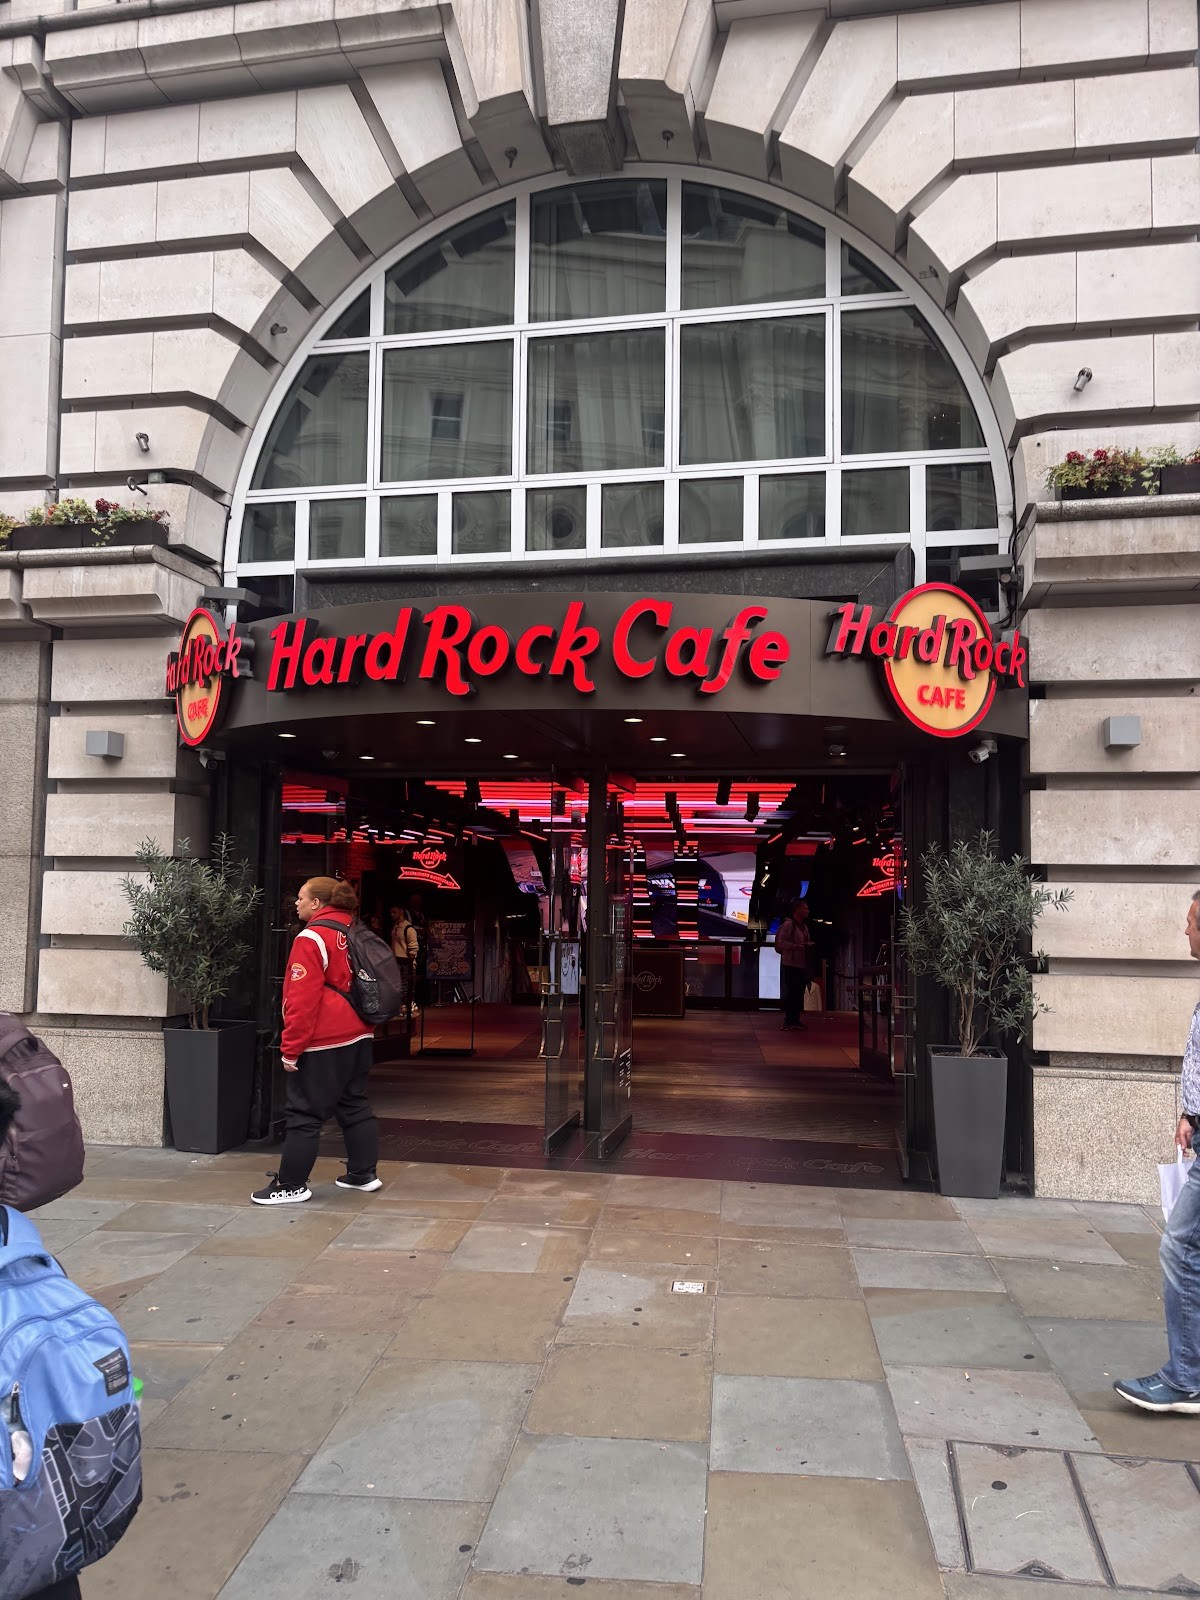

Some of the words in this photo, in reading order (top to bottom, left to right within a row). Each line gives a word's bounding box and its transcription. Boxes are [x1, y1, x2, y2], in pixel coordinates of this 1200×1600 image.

[166, 639, 193, 696] Hard
[193, 622, 242, 688] Rock
[266, 607, 413, 691] Hard
[419, 602, 600, 696] Rock
[613, 598, 791, 694] Cafe
[834, 602, 947, 664] Hard
[950, 618, 1027, 688] Rock
[917, 685, 966, 710] CAFE
[270, 1187, 305, 1200] adidas
